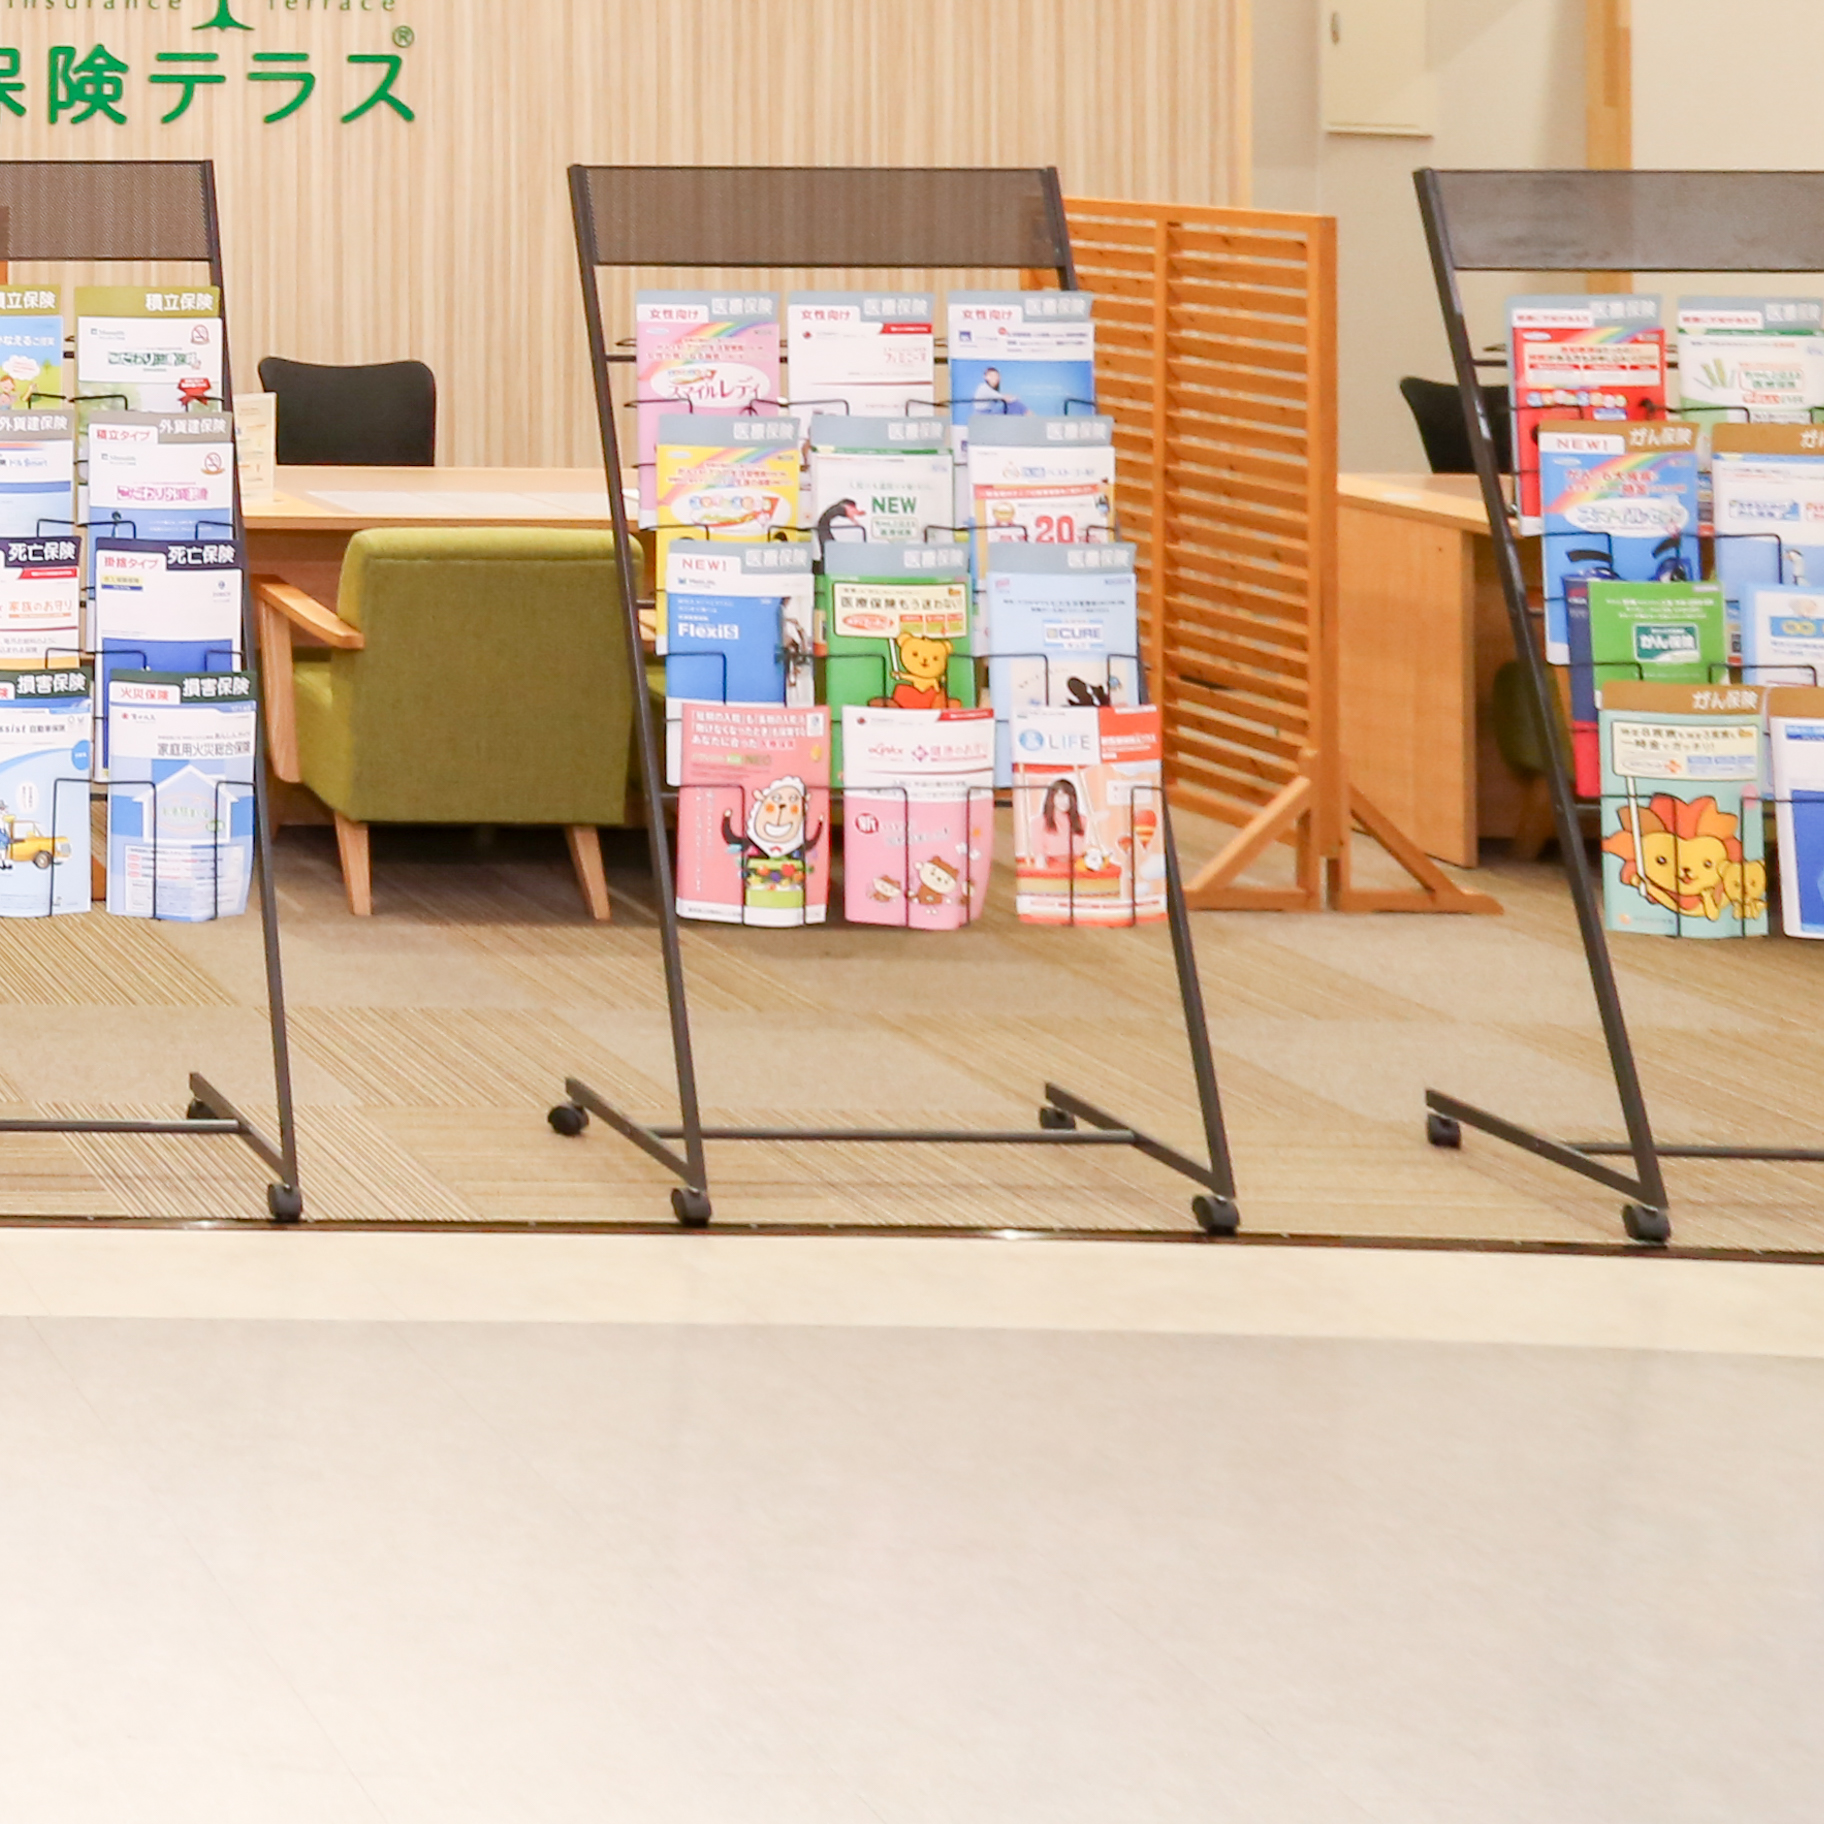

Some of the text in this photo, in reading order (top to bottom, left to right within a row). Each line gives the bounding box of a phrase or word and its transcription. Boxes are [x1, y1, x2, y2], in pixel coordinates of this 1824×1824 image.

[144, 293, 214, 312] 積立保険
[711, 297, 774, 316] 医療保険
[863, 298, 928, 317] 医療保険
[1024, 298, 1087, 317] 医療保険
[1589, 300, 1657, 319] 医療保険
[649, 308, 699, 320] 女性向け
[801, 309, 851, 321] 女性向け
[962, 309, 1013, 321] 女性向け
[1764, 303, 1821, 322] 医療保険
[96, 428, 150, 441] 積立タイプ
[159, 418, 228, 434] 外貨建保険
[733, 422, 795, 440] 医療保険
[1556, 438, 1609, 452] NEW!
[1628, 426, 1694, 446] がん保険
[872, 496, 917, 514] NEW
[1035, 515, 1075, 543] 20
[8, 542, 77, 562] 死亡保険
[167, 544, 236, 565] 死亡保険
[745, 548, 808, 567] 医療保険
[104, 556, 159, 570] 掛捨タイプ
[682, 557, 727, 572] NEW!
[8, 599, 73, 613] 家族のお守り
[1059, 627, 1102, 639] CURE
[16, 673, 87, 694] 損害保険
[183, 677, 250, 698] 損害保険
[120, 687, 170, 701] 火災保険
[1692, 690, 1759, 710] がん保険
[156, 741, 251, 757] 家庭用火災総合保険
